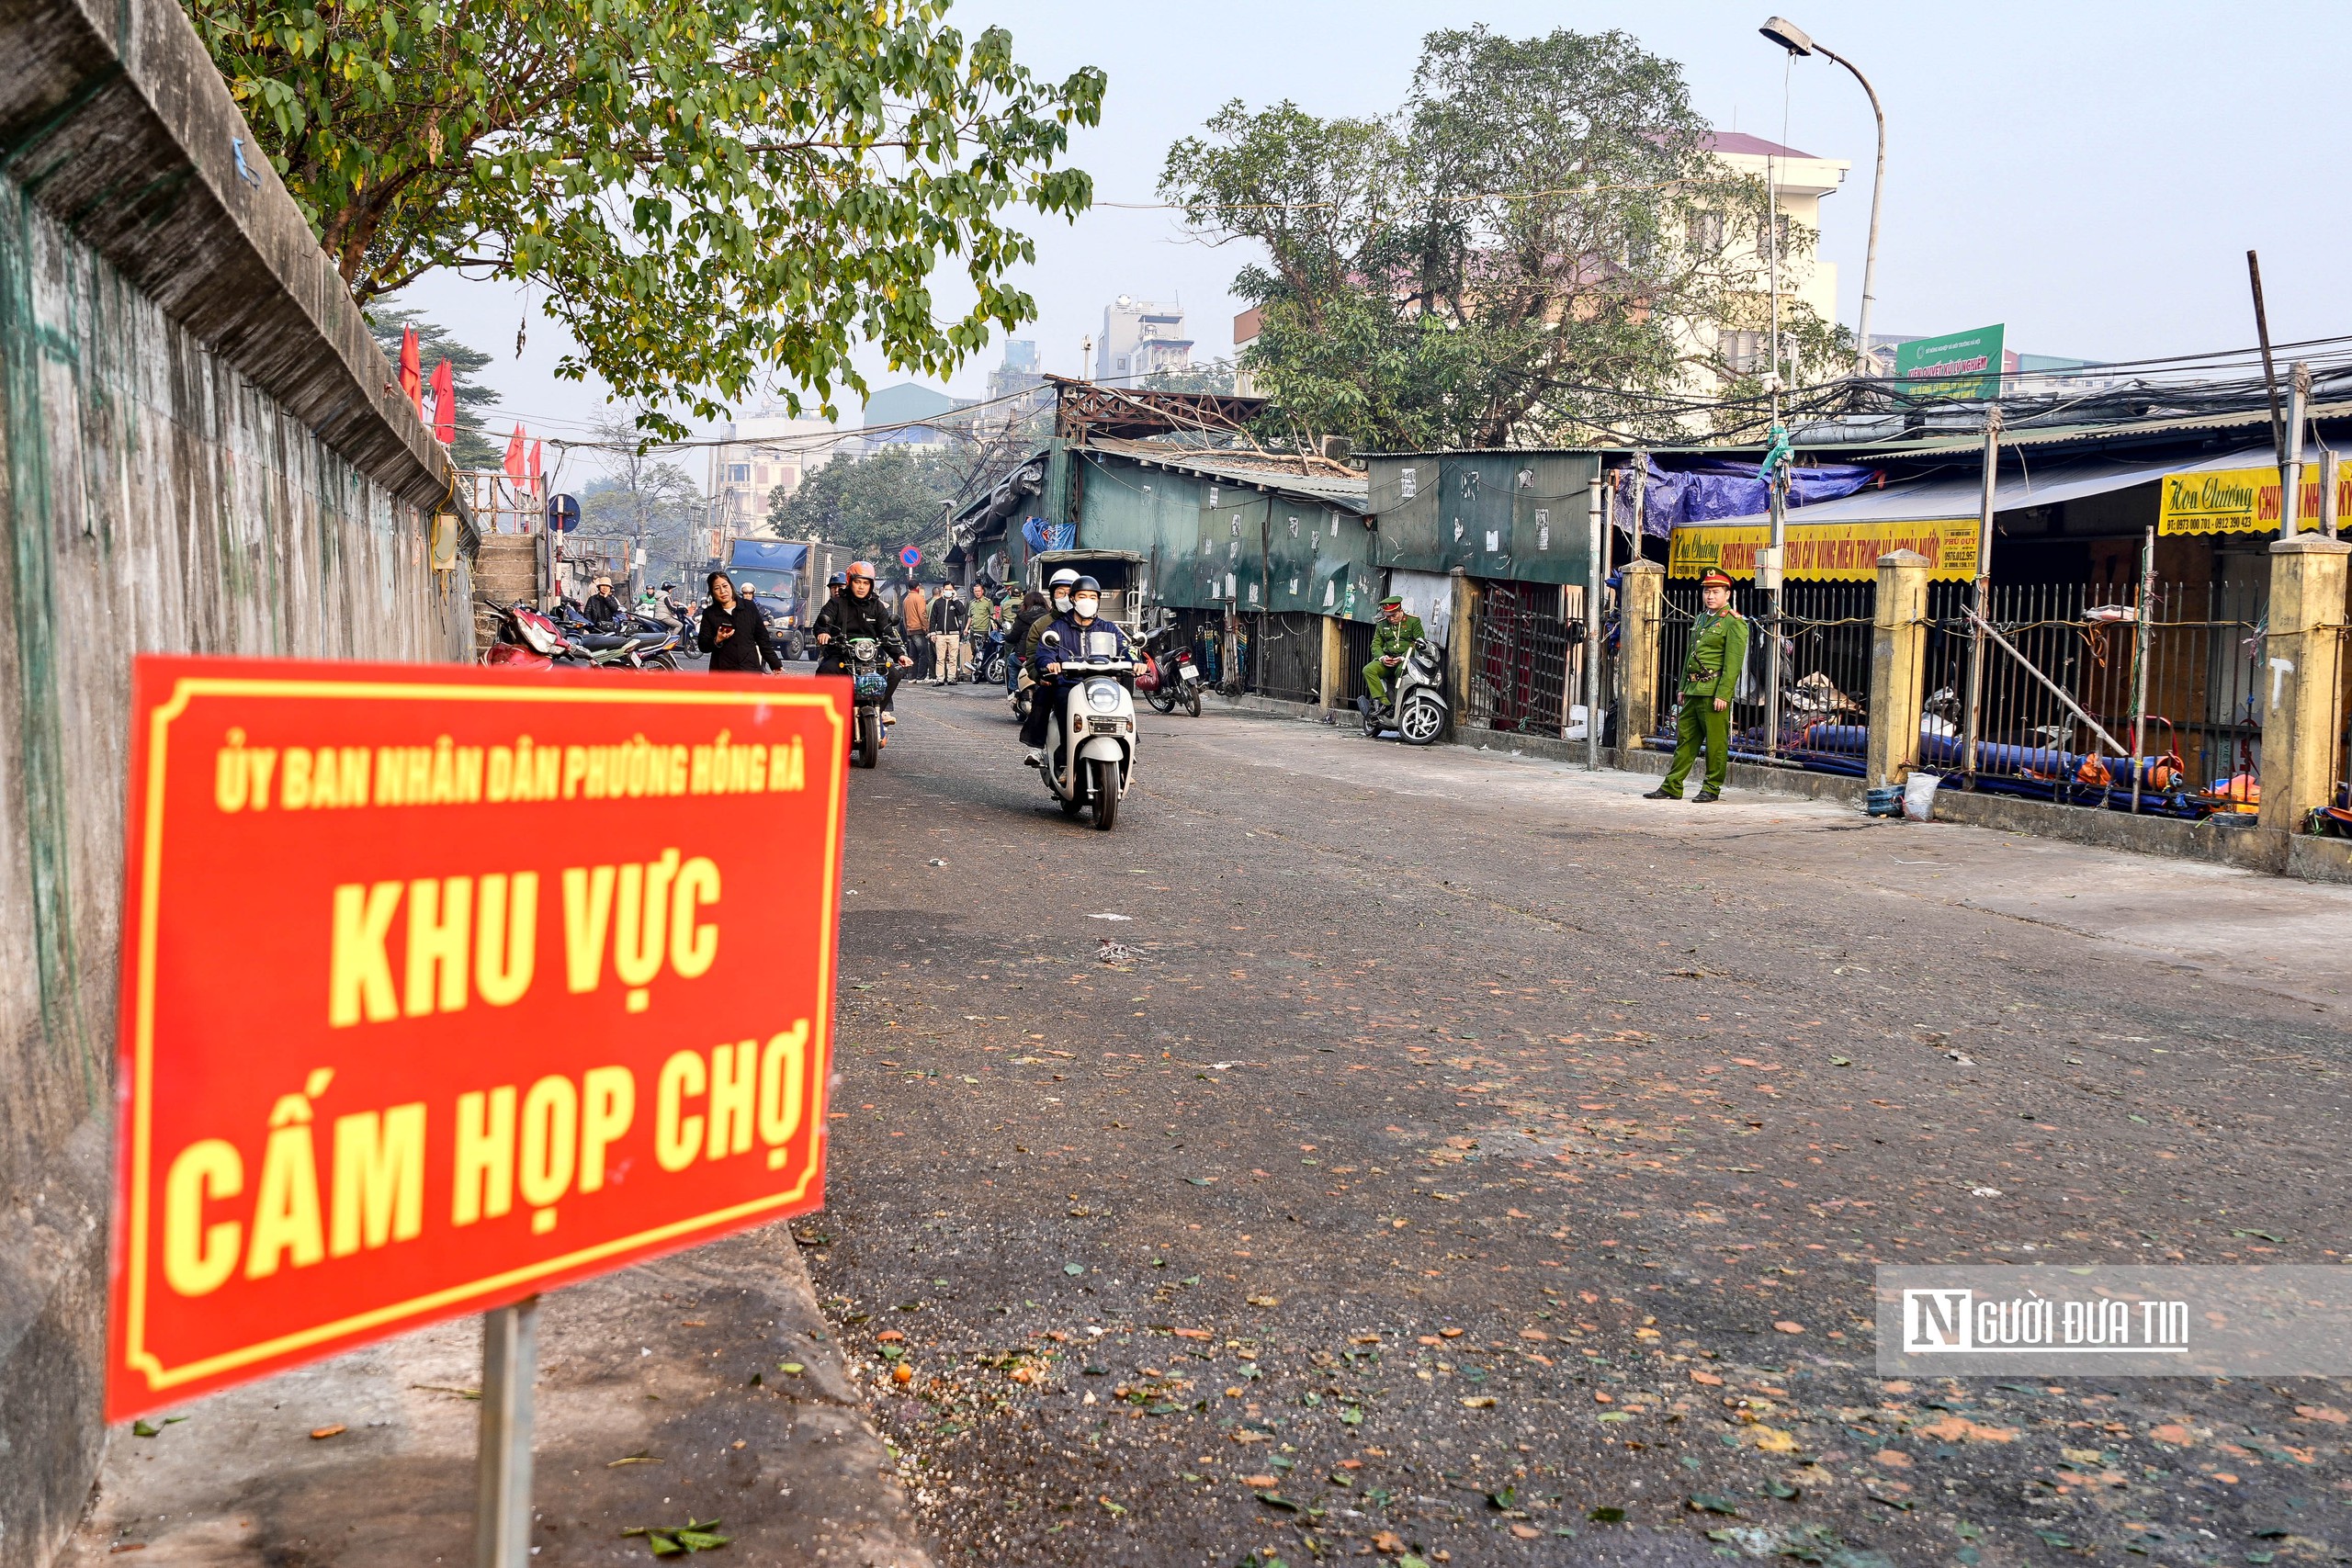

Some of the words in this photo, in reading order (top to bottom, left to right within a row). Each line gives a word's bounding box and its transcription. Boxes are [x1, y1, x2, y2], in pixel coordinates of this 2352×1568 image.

[1962, 355, 1987, 374] NGHIÊM
[2169, 479, 2199, 511] Hoa
[2202, 478, 2254, 514] Chương
[2177, 518, 2189, 530] 0973
[2190, 518, 2200, 530] 000
[2215, 517, 2229, 529] 0912
[2230, 516, 2240, 528] 390
[2241, 516, 2252, 528] 423
[1721, 536, 1746, 570] CHUYÊN
[1786, 533, 1803, 570] TRÁI
[1802, 533, 1816, 570] CÂY
[1817, 532, 1837, 570] VÙNG
[1837, 526, 1856, 570] MIỀN
[1856, 538, 1881, 570] TRONG
[215, 727, 278, 814] ỦY
[279, 745, 371, 811] BAN
[373, 734, 484, 807] NHÂN
[486, 734, 561, 804] DÂN
[562, 732, 689, 801] PHƯỜNG
[768, 734, 806, 793] HÀ
[329, 870, 538, 1028] KHU
[561, 847, 722, 1014] VỰC
[162, 1066, 427, 1297] CẤM
[450, 1064, 638, 1235] HỌP
[654, 1018, 811, 1171] CHỢ
